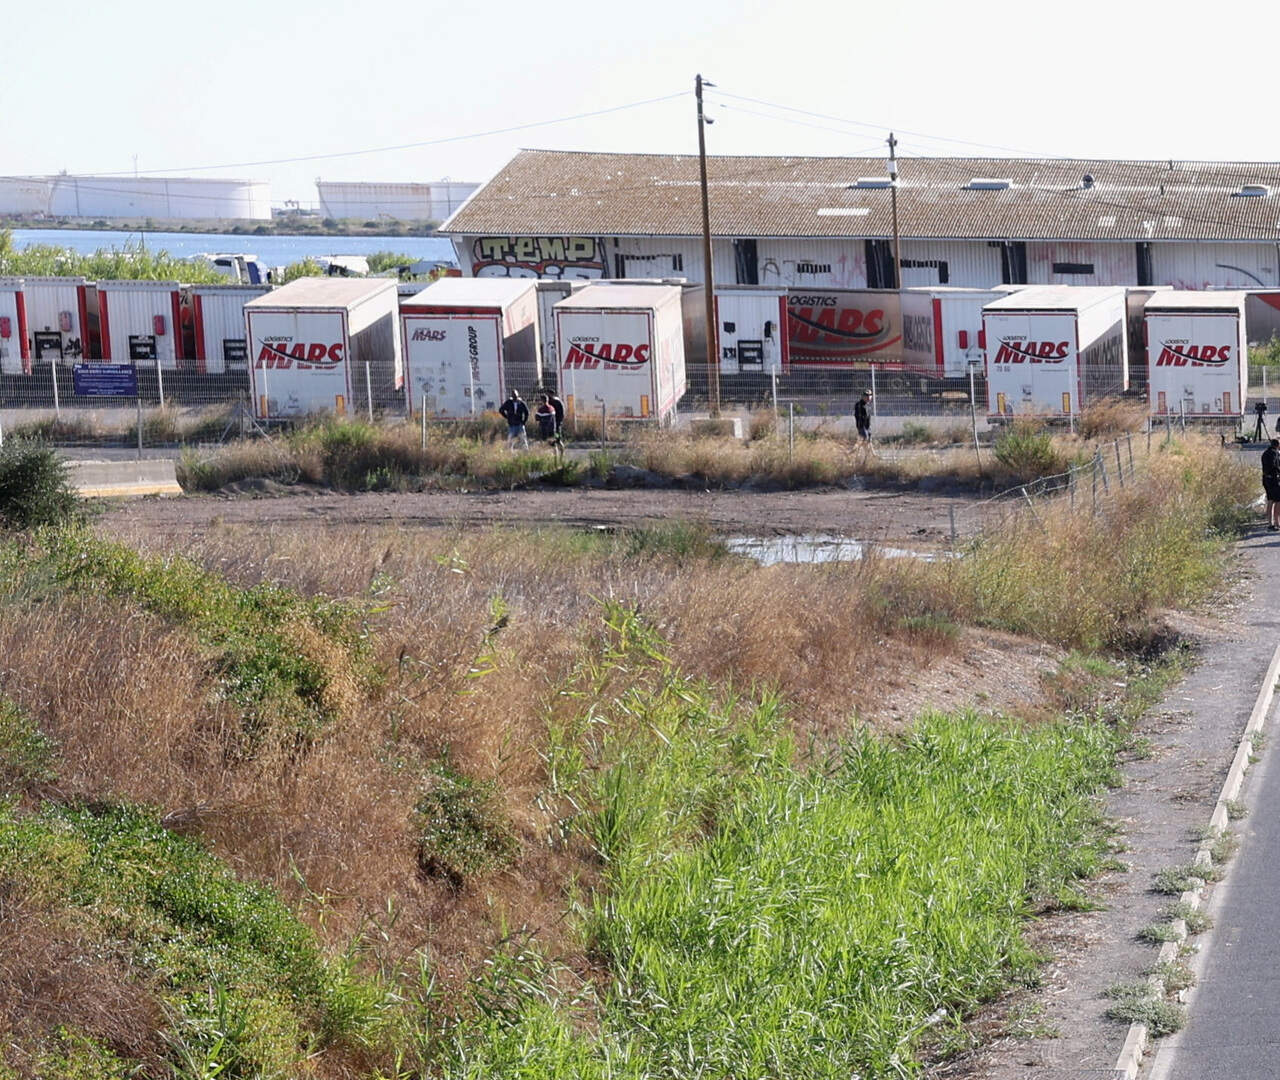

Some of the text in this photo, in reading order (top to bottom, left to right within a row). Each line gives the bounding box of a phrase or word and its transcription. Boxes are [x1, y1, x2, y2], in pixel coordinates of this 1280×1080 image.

[467, 325, 479, 356] GROUP
[994, 341, 1070, 364] MARS
[255, 343, 344, 370] MARS
[562, 343, 650, 370] MARS
[1156, 345, 1232, 367] MARS
